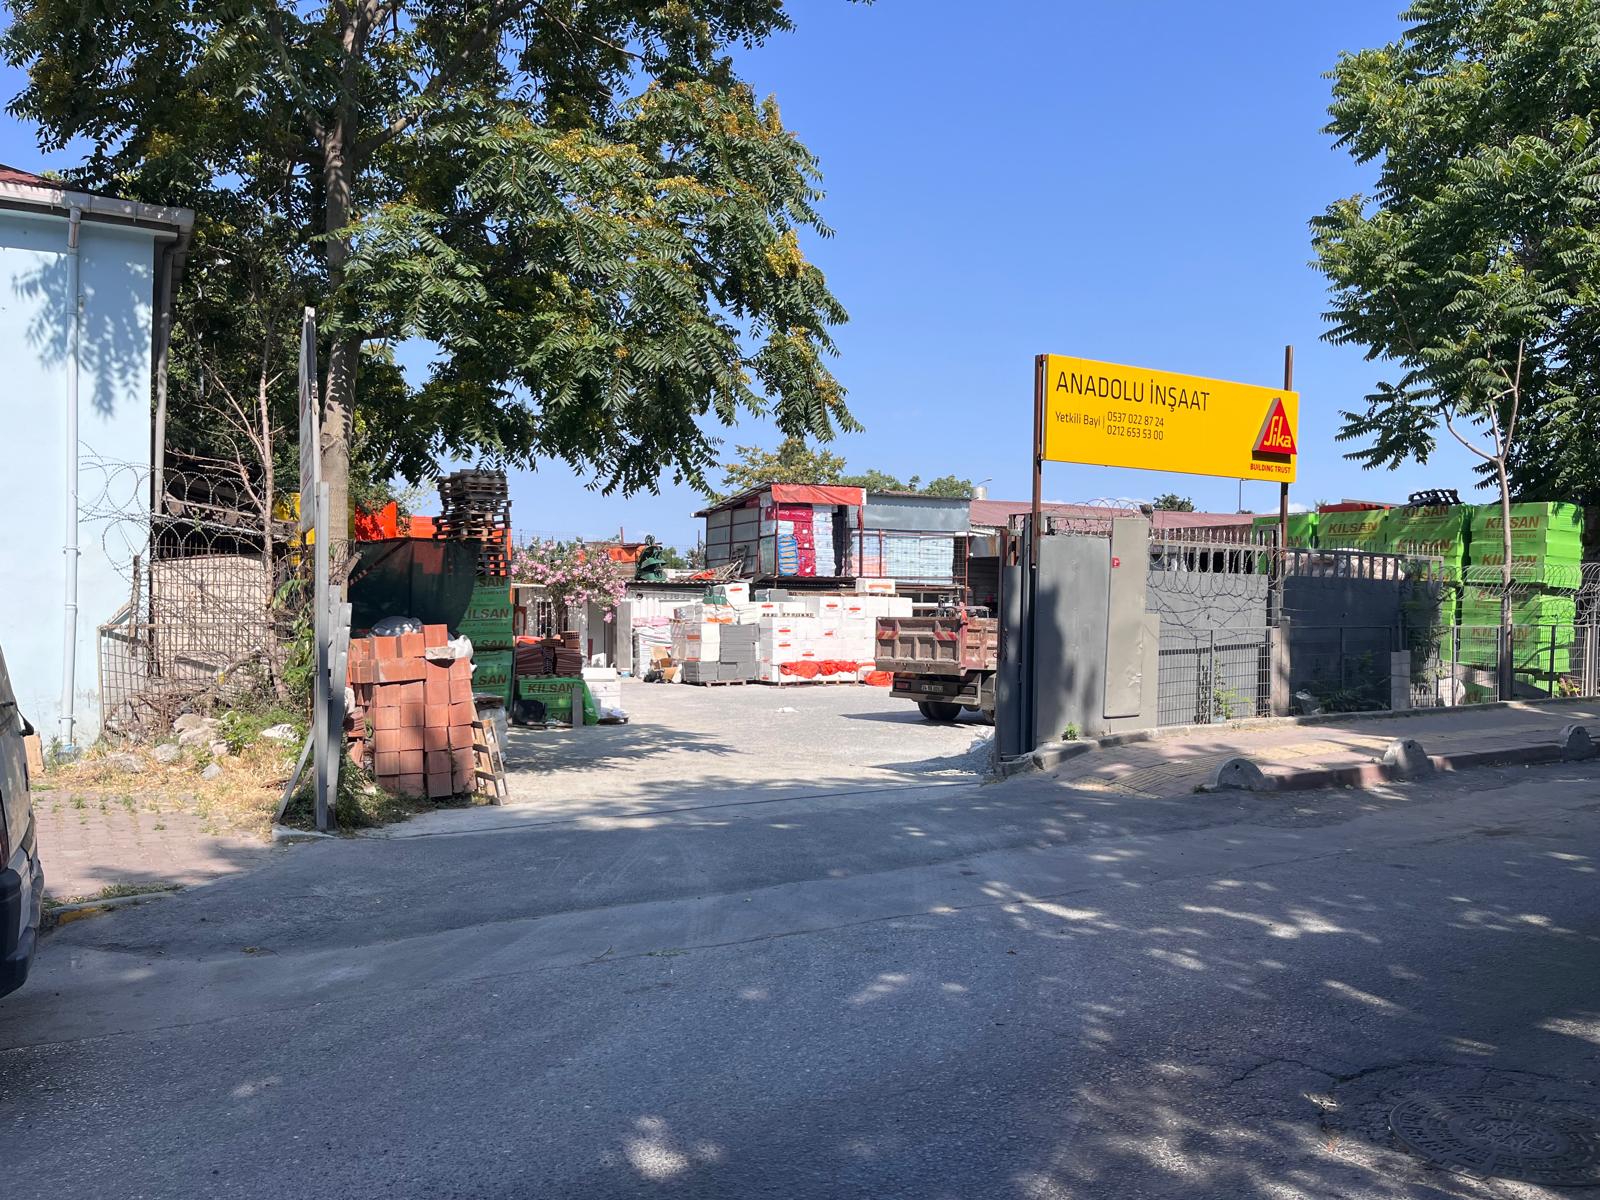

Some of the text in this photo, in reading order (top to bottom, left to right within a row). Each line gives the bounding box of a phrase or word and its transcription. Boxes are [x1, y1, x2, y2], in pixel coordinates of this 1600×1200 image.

[1056, 371, 1211, 412] ANADOLU İNŞAAT
[1055, 411, 1101, 428] Yetkili Bayi
[1107, 411, 1164, 428] 0537 022 87 24
[1106, 425, 1164, 441] 0212 653 53 00
[1263, 415, 1292, 449] Sika
[1250, 463, 1291, 475] BUILDING TRUST
